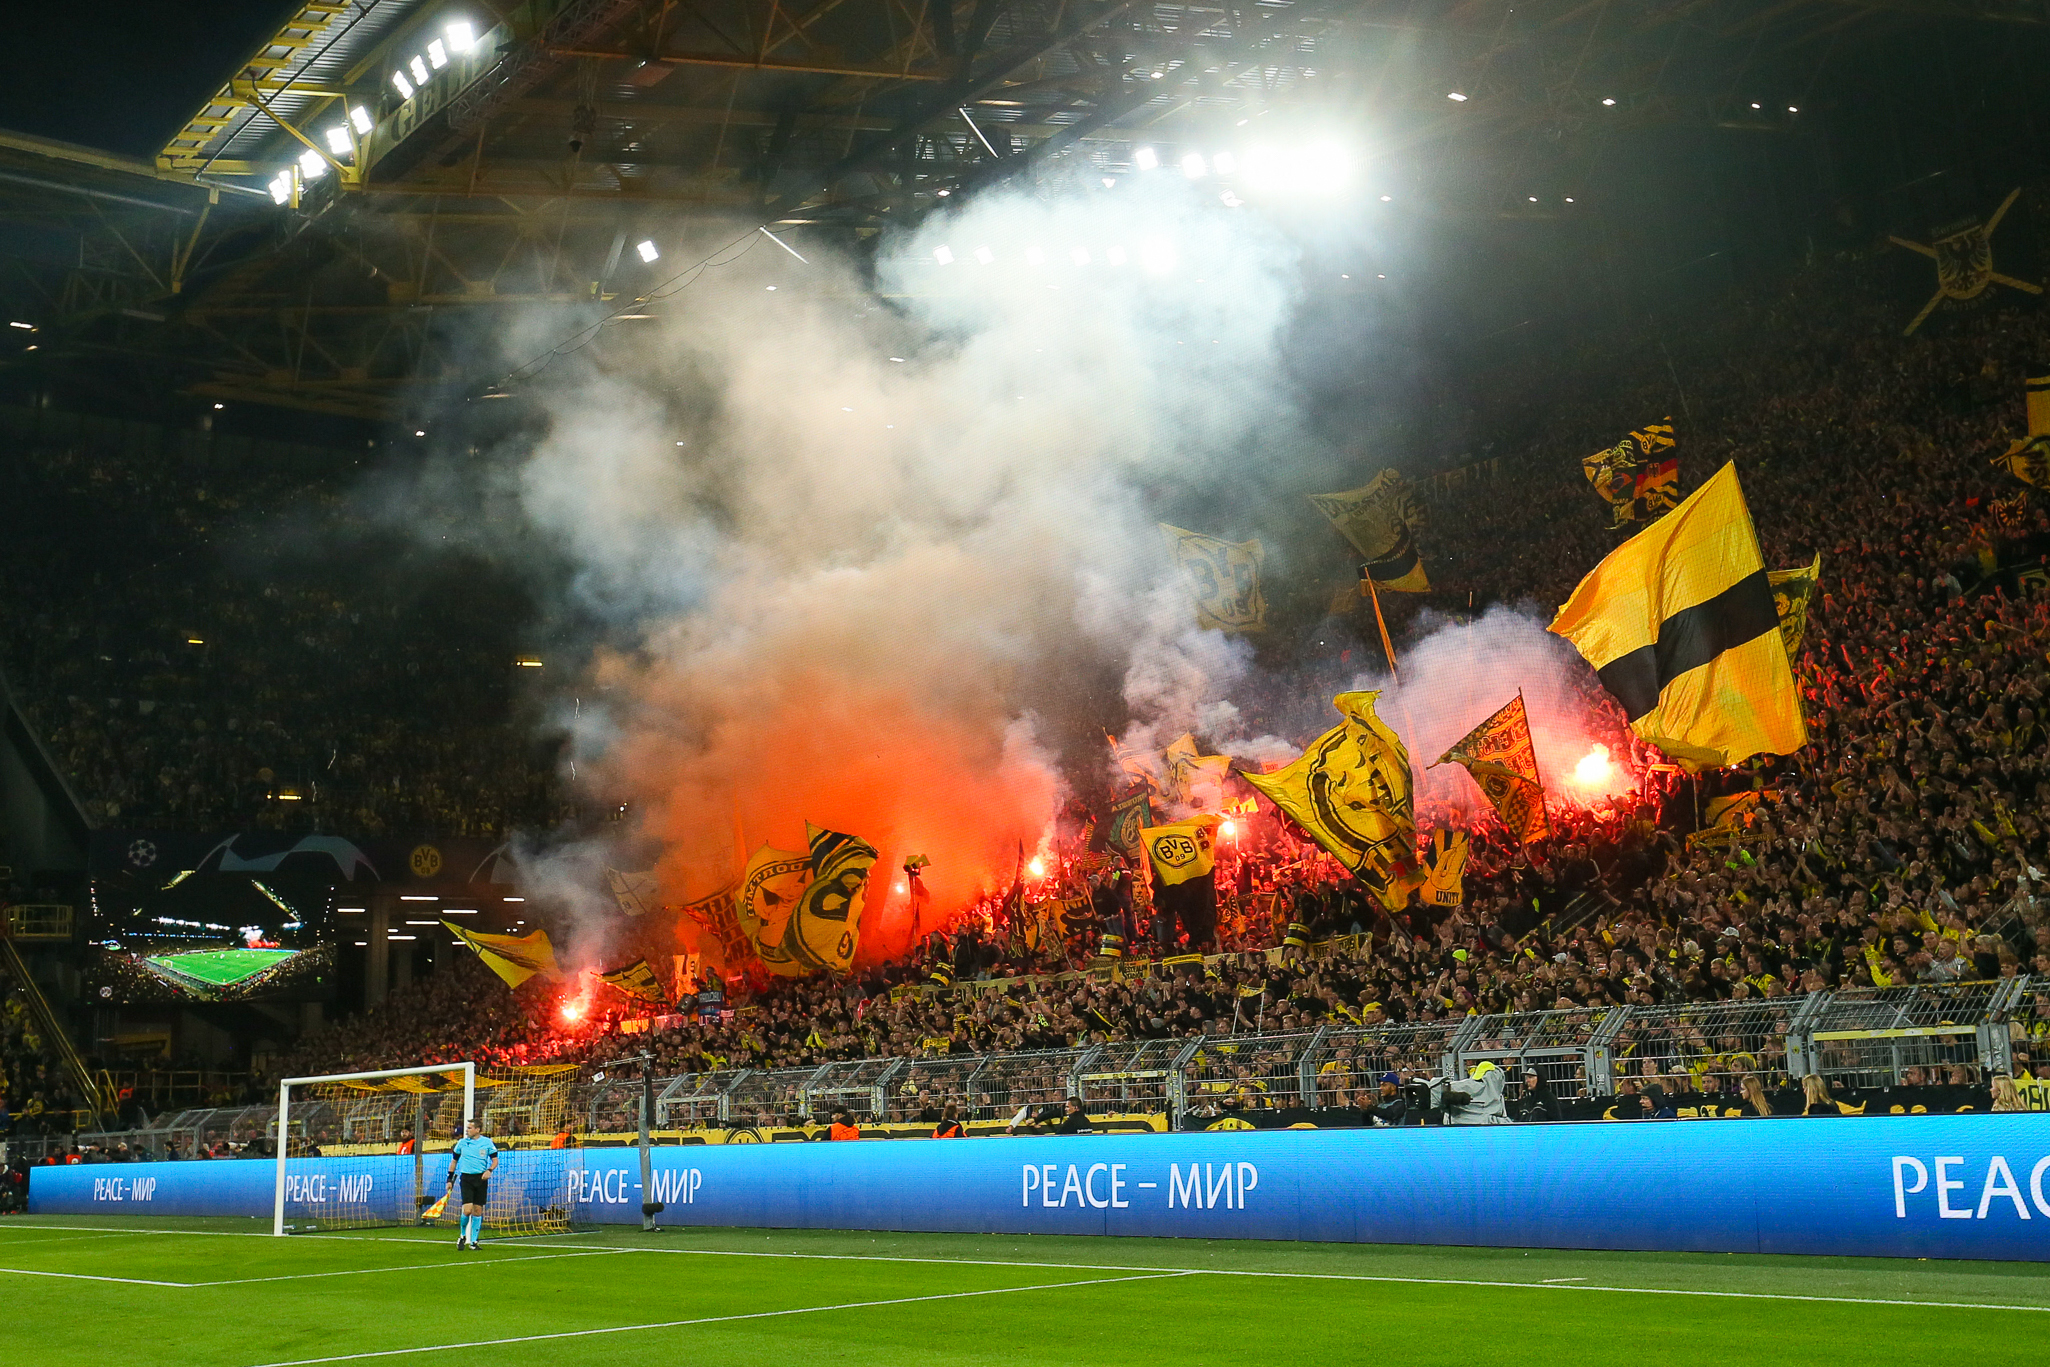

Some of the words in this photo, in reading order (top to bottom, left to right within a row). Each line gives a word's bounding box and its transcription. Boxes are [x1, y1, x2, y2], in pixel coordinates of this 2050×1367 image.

[414, 848, 438, 867] BVB
[1160, 839, 1193, 859] BVB
[1175, 853, 1186, 861] 09
[1435, 890, 1460, 904] UNITY
[93, 1177, 124, 1201] PEACE
[131, 1177, 156, 1201] МИР
[285, 1174, 326, 1203] PEACE
[339, 1174, 373, 1203] МИР
[567, 1169, 629, 1204] PEACE
[650, 1168, 702, 1204] МИР
[1022, 1162, 1130, 1209] PEACE
[1168, 1161, 1259, 1210] МИР
